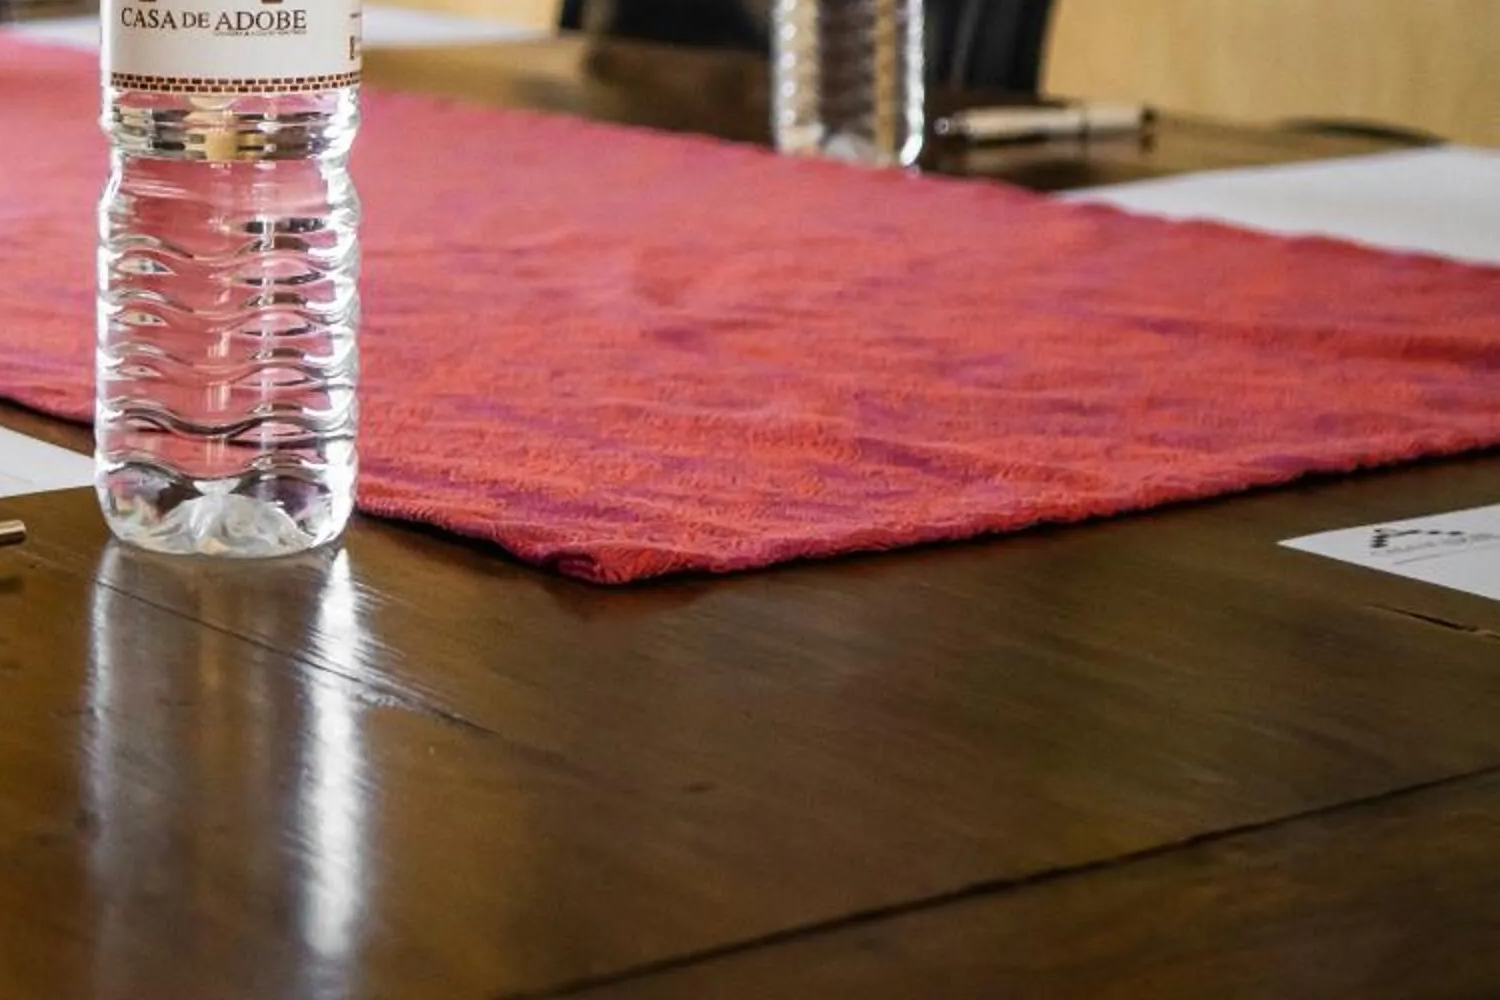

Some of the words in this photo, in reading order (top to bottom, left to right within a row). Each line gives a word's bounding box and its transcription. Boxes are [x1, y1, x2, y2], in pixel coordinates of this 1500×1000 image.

[121, 7, 177, 30] CASA
[182, 11, 210, 29] DE
[214, 9, 307, 31] ADOBE
